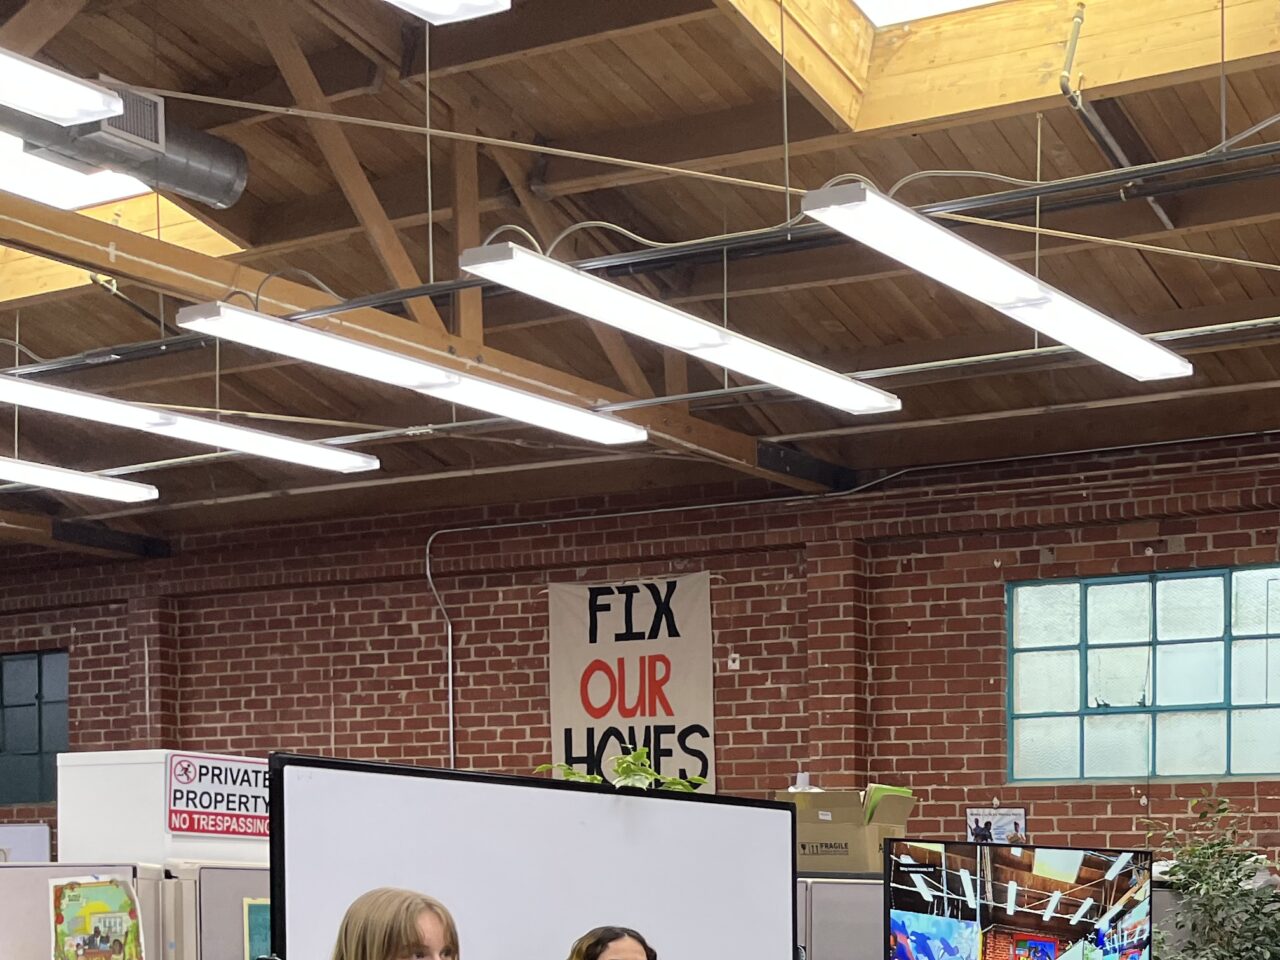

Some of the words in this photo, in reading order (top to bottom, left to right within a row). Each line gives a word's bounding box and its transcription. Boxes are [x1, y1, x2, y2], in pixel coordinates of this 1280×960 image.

[588, 580, 680, 643] FIX
[580, 654, 675, 719] OUR
[199, 765, 269, 788] PRIVATE
[173, 789, 269, 814] PROPERTY
[171, 813, 190, 829] NO
